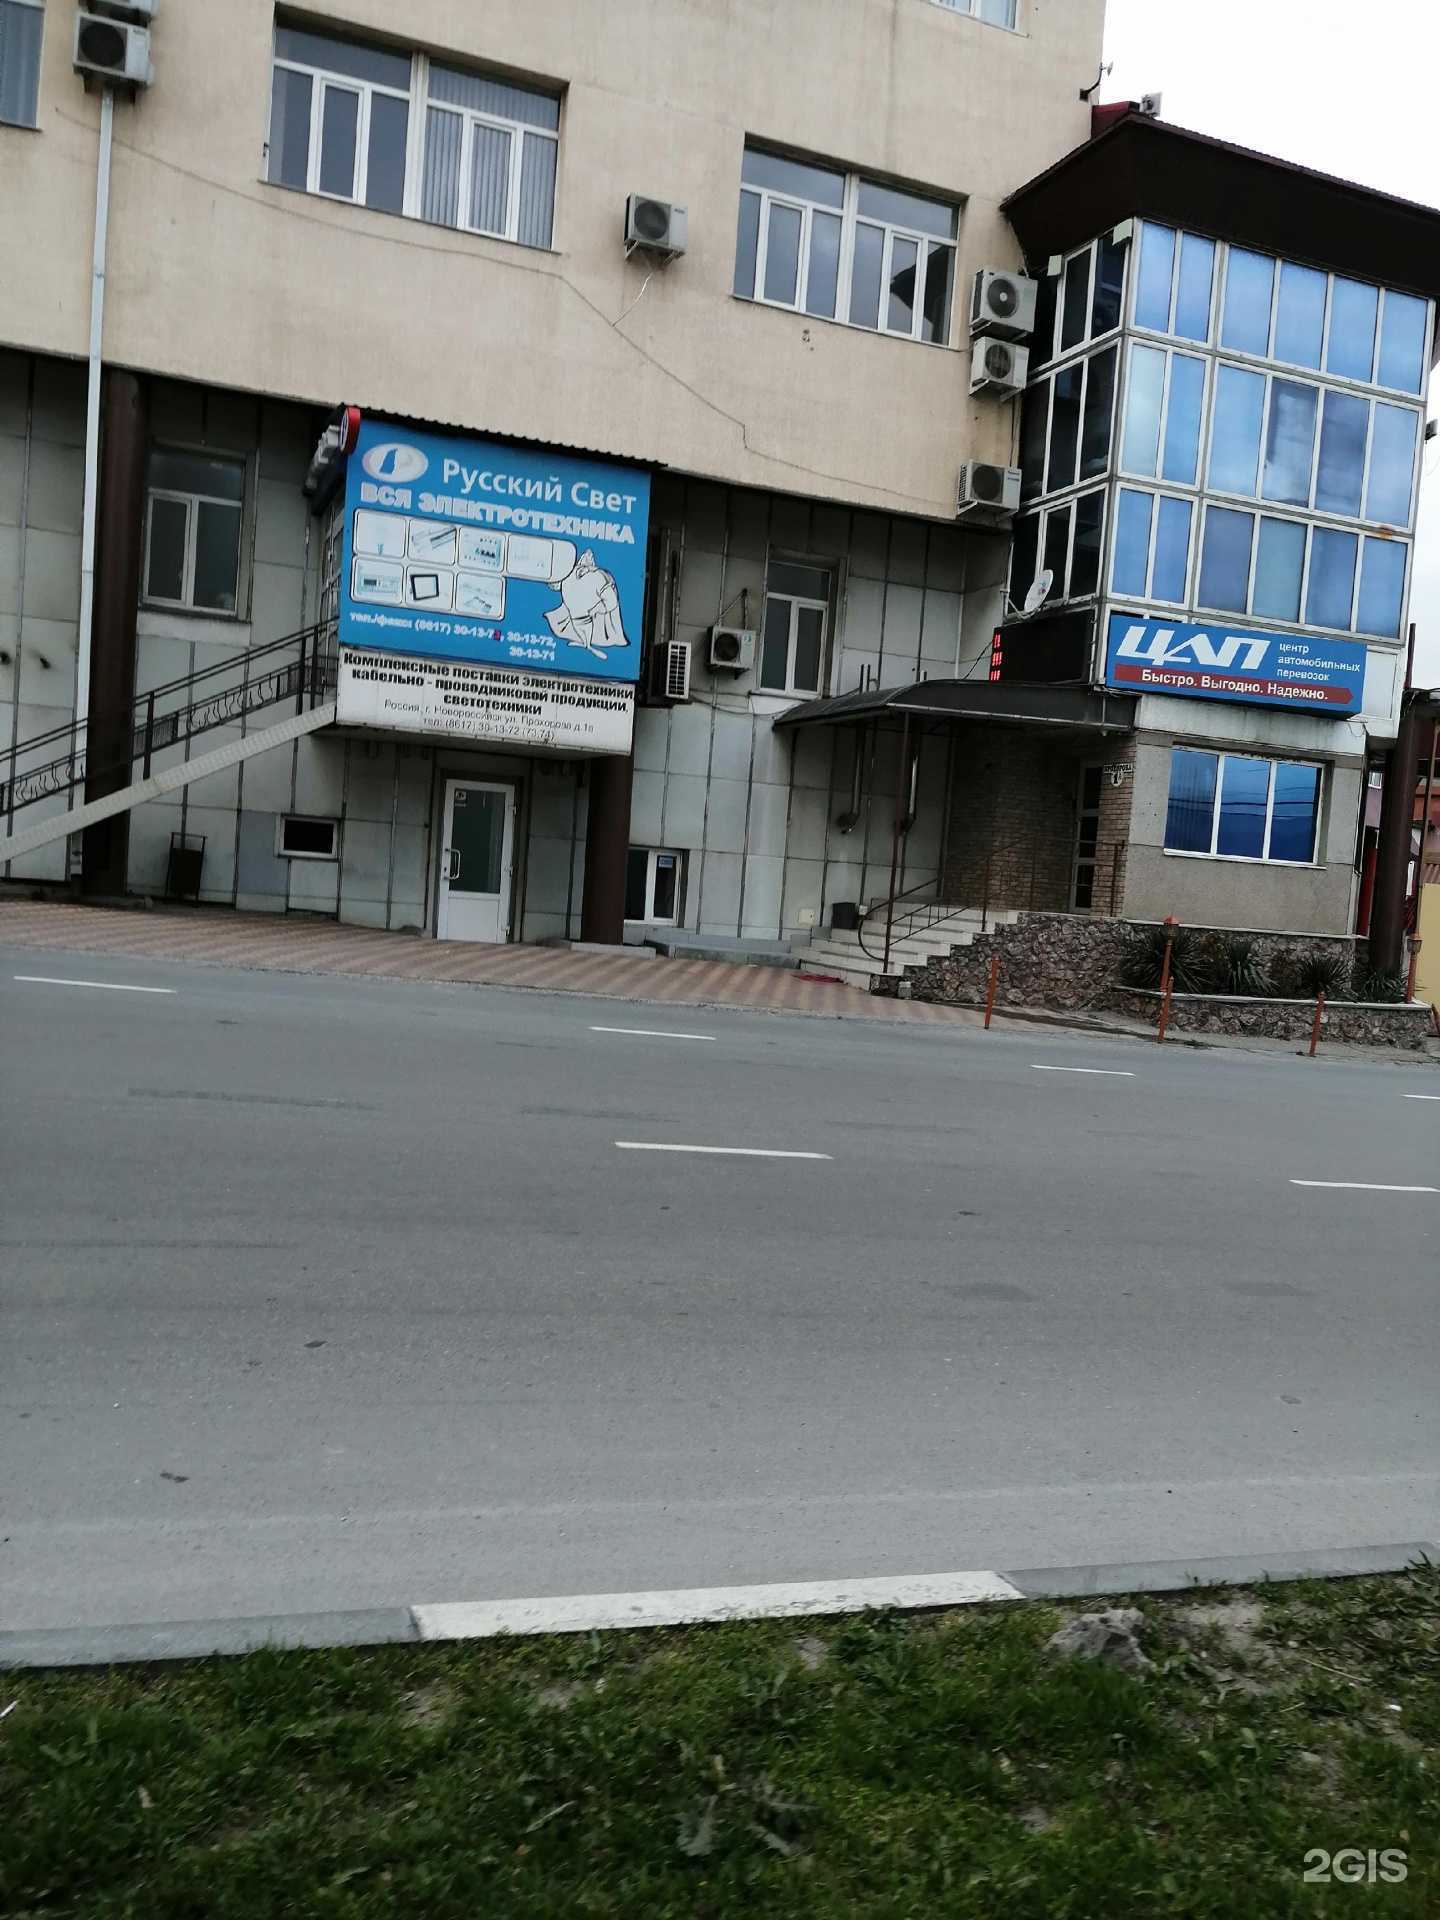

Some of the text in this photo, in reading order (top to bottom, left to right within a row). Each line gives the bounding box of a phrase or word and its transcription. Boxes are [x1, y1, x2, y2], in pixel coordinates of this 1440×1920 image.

[443, 459, 637, 514] Русский Свет
[360, 483, 635, 544] ВСЯ ЭЛЕКТРОТЕХНИКА
[1116, 626, 1271, 670] ЦАП
[1277, 656, 1360, 672] автомобильных
[1279, 643, 1310, 655] центр
[344, 653, 633, 699] Комплексные поставки электротехники
[352, 669, 424, 686] кабельно
[435, 679, 548, 702] проводниковой
[1141, 669, 1328, 700] Быстро. Выгодно. Надежно.
[1276, 668, 1330, 680] перевозок
[443, 694, 542, 715] светотехники
